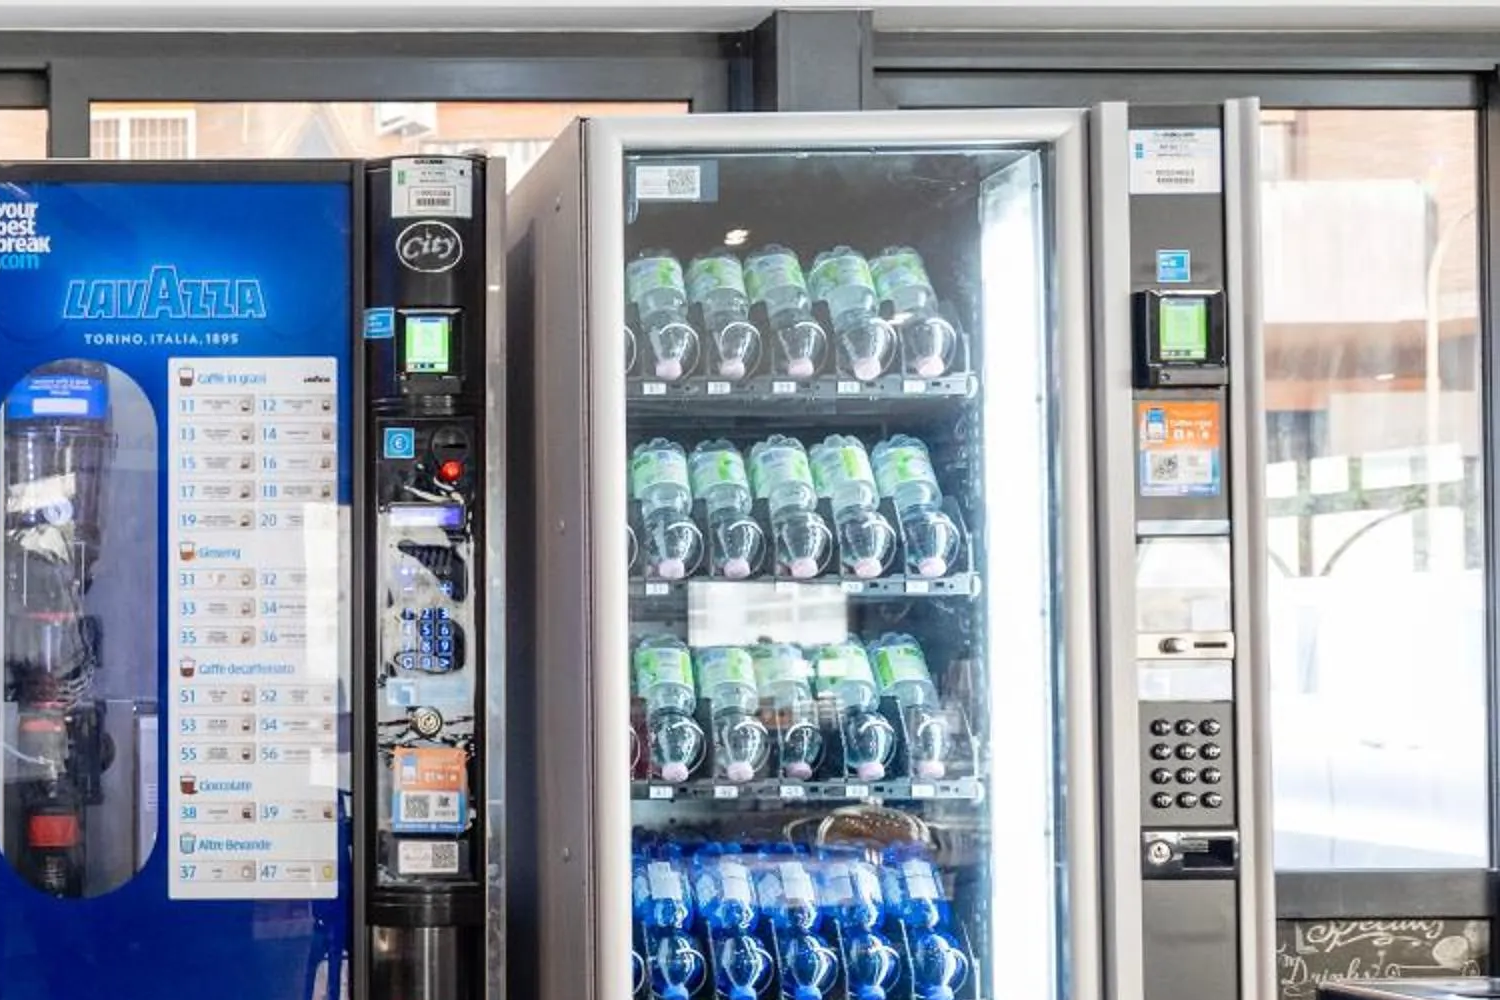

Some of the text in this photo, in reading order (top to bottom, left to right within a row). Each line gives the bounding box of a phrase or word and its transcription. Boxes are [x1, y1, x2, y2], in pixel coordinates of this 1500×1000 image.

[402, 229, 457, 259] City
[63, 266, 266, 318] LAVAZZA
[84, 333, 238, 345] TORINO, ITALIA, 1895
[263, 399, 276, 411] 12
[181, 428, 195, 440] 13
[263, 428, 277, 440] 14
[181, 457, 195, 469] 15
[263, 457, 276, 469] 16
[181, 486, 195, 498] 17
[181, 514, 196, 526] 19
[261, 514, 276, 526] 20
[181, 602, 196, 614] 33
[261, 602, 277, 614] 34
[181, 631, 196, 643] 35
[262, 630, 277, 643] 36
[180, 690, 195, 702] 51
[261, 690, 277, 702] 52
[181, 719, 196, 731] 53
[262, 719, 277, 731] 54
[181, 748, 196, 760] 55
[181, 807, 196, 819] 38
[262, 806, 278, 819] 39
[199, 838, 271, 851] Altre Bevande
[180, 866, 196, 878] 37
[261, 866, 277, 878] 47
